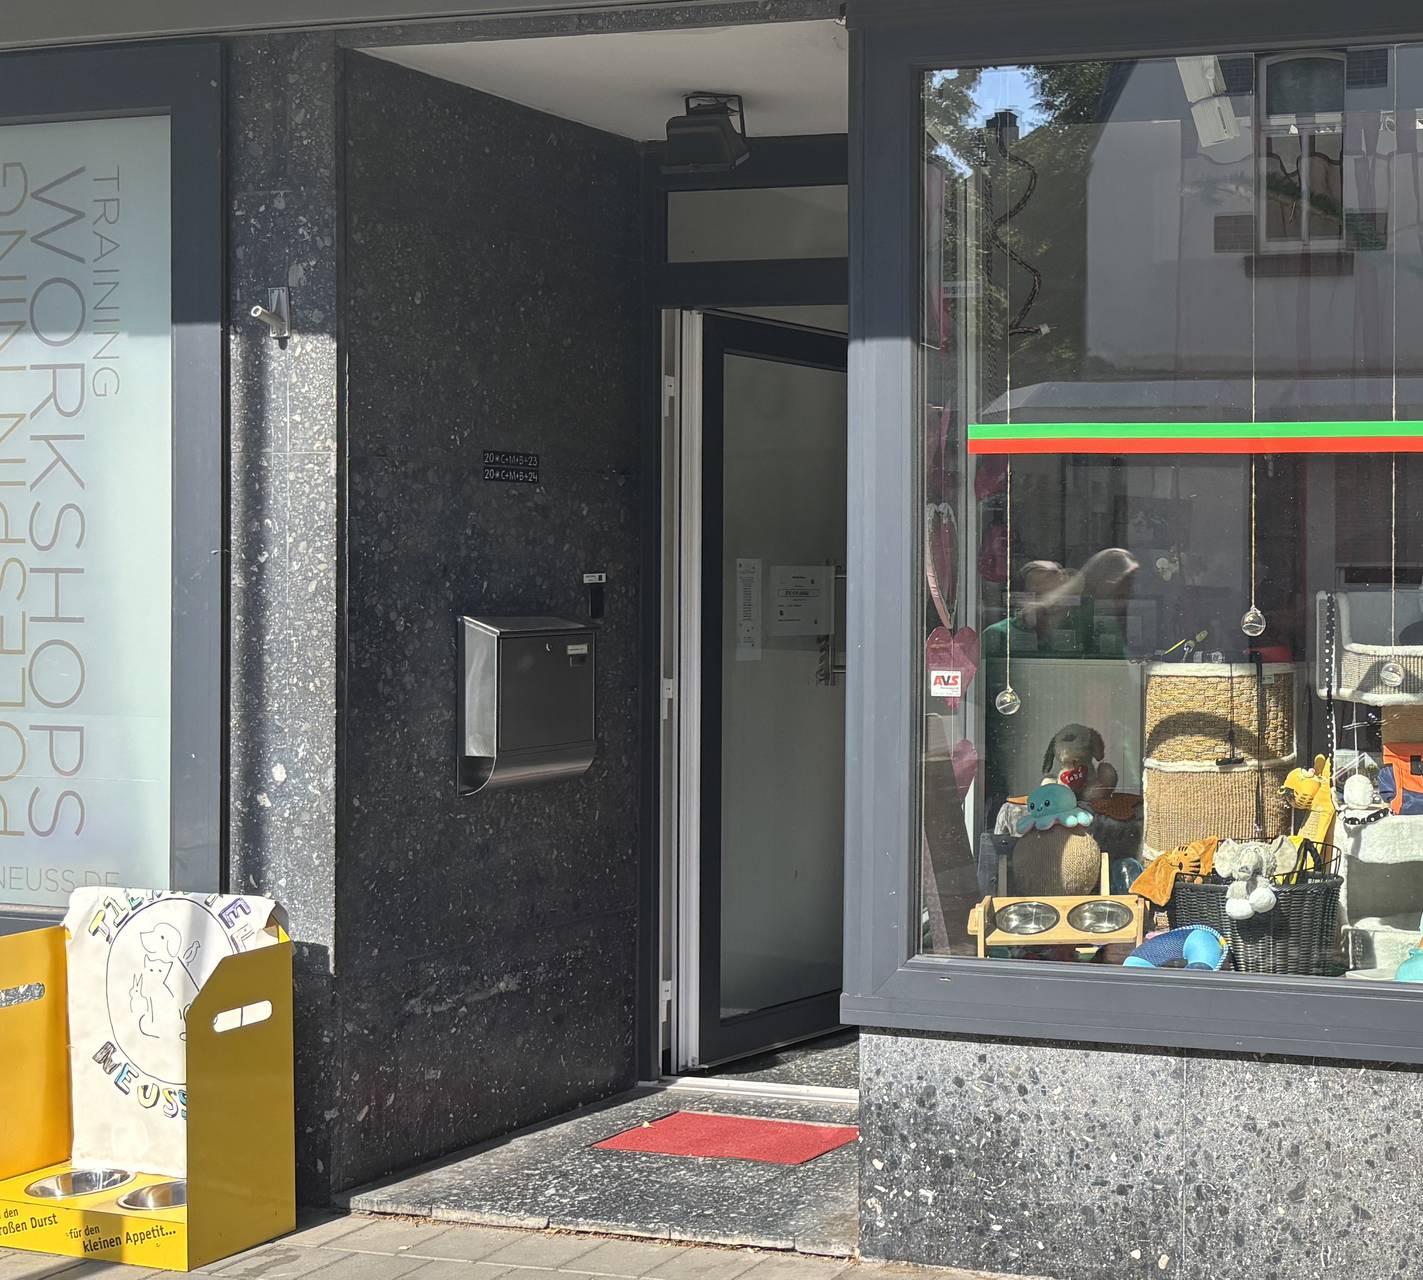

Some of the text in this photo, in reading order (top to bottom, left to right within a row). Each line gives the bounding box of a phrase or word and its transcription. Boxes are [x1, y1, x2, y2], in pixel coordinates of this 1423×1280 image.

[92, 165, 120, 397] TRAINING
[28, 166, 86, 837] WORKSHOPS
[933, 675, 959, 686] AVS
[4, 1209, 19, 1218] den
[30, 1213, 58, 1229] Durst
[84, 1225, 100, 1236] den
[83, 1225, 176, 1253] kleinen Appetit...
